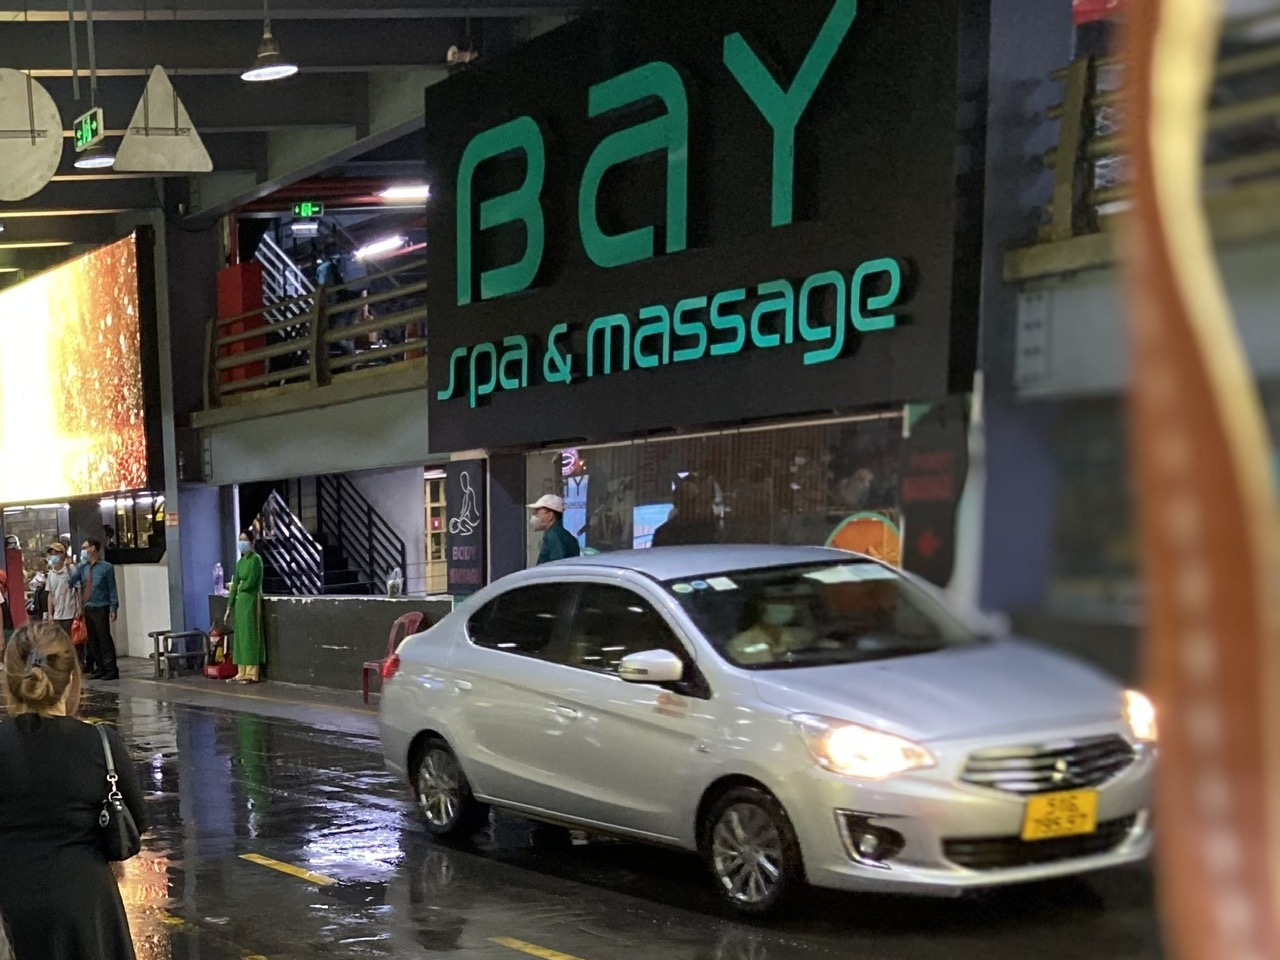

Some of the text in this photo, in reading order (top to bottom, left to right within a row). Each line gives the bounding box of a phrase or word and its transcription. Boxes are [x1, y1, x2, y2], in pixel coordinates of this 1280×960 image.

[437, 257, 902, 408] spa & massage
